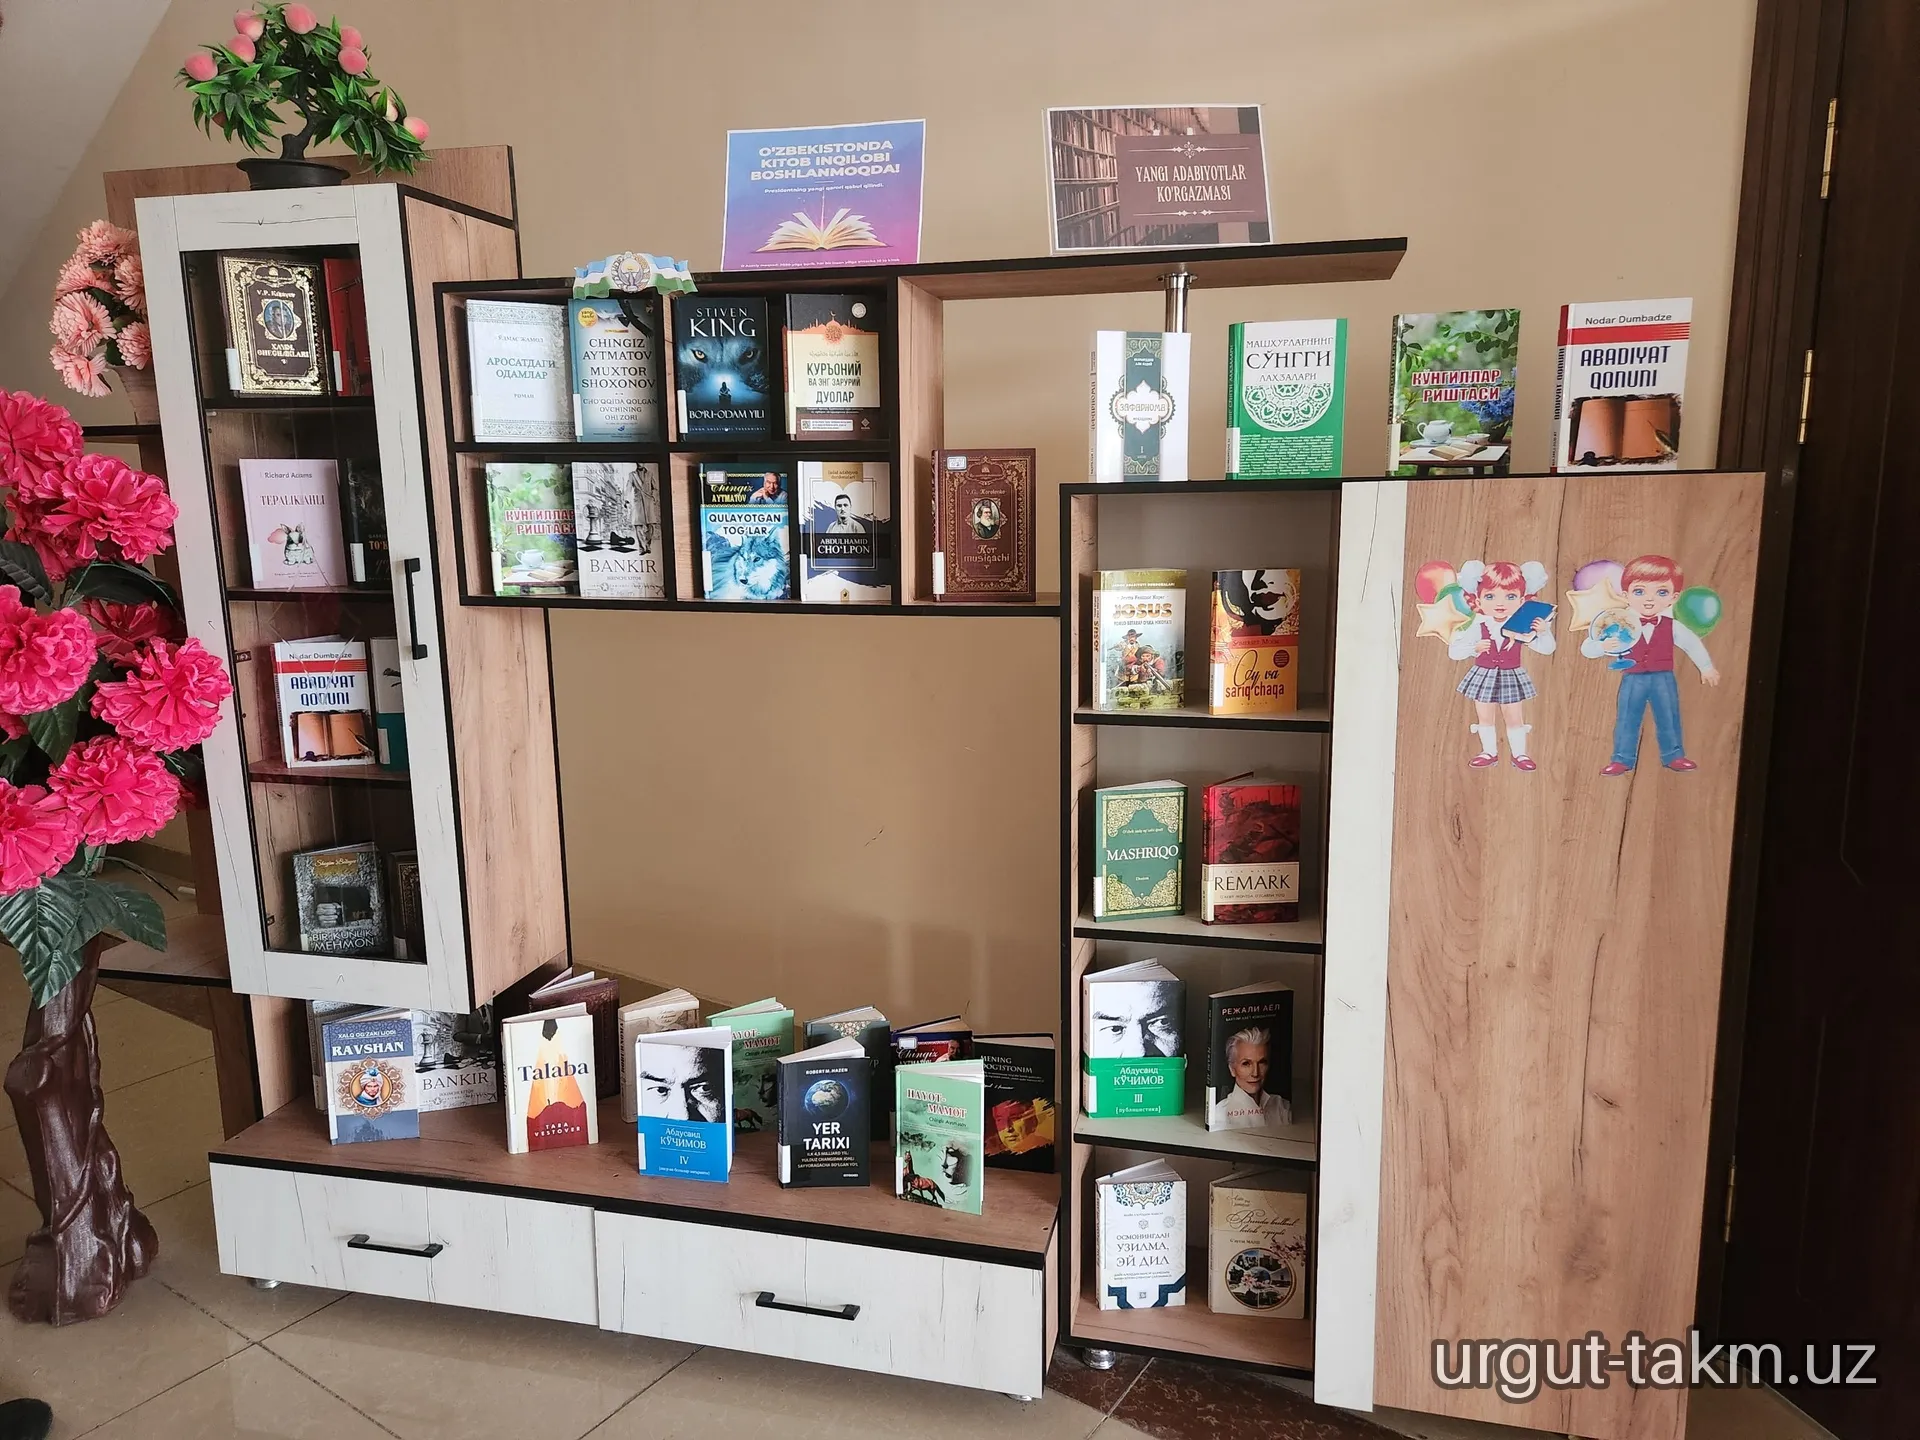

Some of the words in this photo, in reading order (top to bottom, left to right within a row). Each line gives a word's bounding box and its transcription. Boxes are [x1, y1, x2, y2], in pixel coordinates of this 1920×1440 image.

[759, 140, 893, 157] O'ZBEKISTONDA
[761, 156, 811, 168] KITOB
[816, 153, 890, 167] INQILOBI
[751, 164, 900, 181] BOSHLANMOQDA!
[1135, 165, 1169, 182] YANGI
[1172, 164, 1247, 182] ADABIYOTLAR
[1156, 185, 1232, 203] KO'RGAZMASI
[696, 307, 748, 318] STIVEN
[1585, 315, 1617, 326] Nodar
[1618, 313, 1672, 325] Dumbadze
[690, 318, 756, 337] KING
[589, 338, 646, 348] CHINGIZ
[583, 350, 652, 361] AYTMATOV
[1246, 350, 1332, 370] СЎНГГИ
[1580, 345, 1672, 367] ABADIYAT
[487, 357, 556, 369] АРОСАТДАГИ
[496, 369, 548, 380] ОДАМЛАР
[590, 366, 647, 376] MUXTOR
[1410, 367, 1501, 386] КЎНГИЛЛАР
[581, 379, 656, 389] SHOXONOV
[808, 378, 818, 387] ВА
[818, 378, 830, 387] ЭНГ
[831, 377, 861, 387] ЗАРУРИЙ
[1590, 369, 1658, 390] QONUNI
[815, 391, 855, 404] ДУОЛАР
[1422, 386, 1501, 403] РИШТАСИ
[748, 409, 765, 419] YILI
[710, 481, 753, 494] Chingiz
[711, 493, 747, 503] AYTMATOV
[708, 513, 782, 524] QULAYOTGAN
[722, 526, 768, 536] TOG'LAR
[819, 538, 868, 546] ABDULHAMID
[977, 545, 997, 555] Kor
[963, 553, 1011, 564] musiqachi
[590, 559, 658, 573] BANKIR
[1112, 602, 1172, 619] JOSUS
[1234, 649, 1261, 690] Oy
[1264, 669, 1280, 680] va
[1225, 686, 1251, 701] sariq
[1254, 681, 1285, 700] chaqa
[1106, 845, 1179, 861] MASHRIQO
[1214, 874, 1291, 891] REMARK
[312, 932, 328, 941] BIR
[333, 929, 373, 940] KUNLIK
[313, 937, 374, 951] MEHMON
[1221, 1005, 1260, 1016] РЕЖАЛИ
[331, 1041, 404, 1056] RAVSHAN
[743, 1036, 781, 1049] MAMOT
[980, 1055, 1012, 1064] MENING
[517, 1060, 589, 1082] Talaba
[1119, 1066, 1159, 1076] Абдусаид
[422, 1071, 489, 1091] BANKIR
[1113, 1074, 1165, 1086] КЎЧИМОВ
[1133, 1093, 1144, 1103] III
[927, 1103, 967, 1119] MAMOT
[1227, 1108, 1245, 1117] МЭЙ
[534, 1125, 581, 1137] VESTOVER
[545, 1122, 569, 1130] TARA
[812, 1121, 841, 1135] YER
[665, 1127, 701, 1139] Абдусаид
[660, 1135, 707, 1149] КЎЧИМОВ
[803, 1136, 850, 1150] TARIXI
[679, 1155, 689, 1165] IV
[1116, 1232, 1170, 1241] ОСМОНИНГДАН
[1116, 1241, 1170, 1252] УЗИЛМА,
[1116, 1254, 1136, 1268] ЭЙ
[1138, 1255, 1170, 1268] ДИЛ
